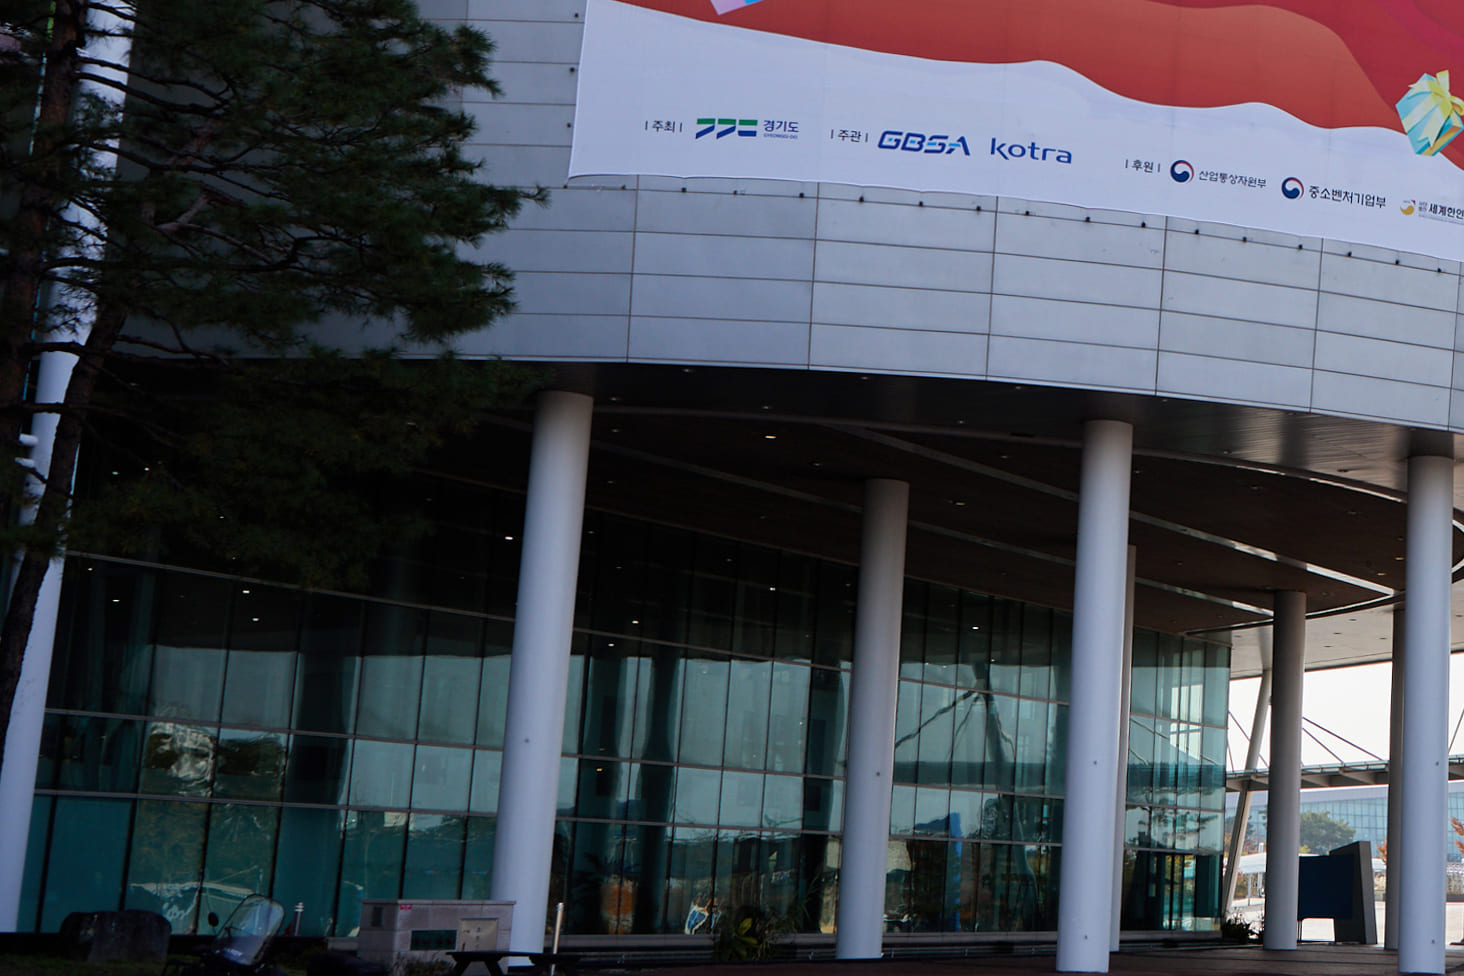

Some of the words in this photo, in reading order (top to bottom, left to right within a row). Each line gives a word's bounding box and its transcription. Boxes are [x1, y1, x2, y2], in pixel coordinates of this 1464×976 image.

[763, 119, 799, 133] 경기도
[877, 130, 970, 156] GBSA
[990, 137, 1073, 164] kotra
[1198, 170, 1267, 189] 산업통상자원부
[1308, 185, 1386, 209] 중소벤처기업부
